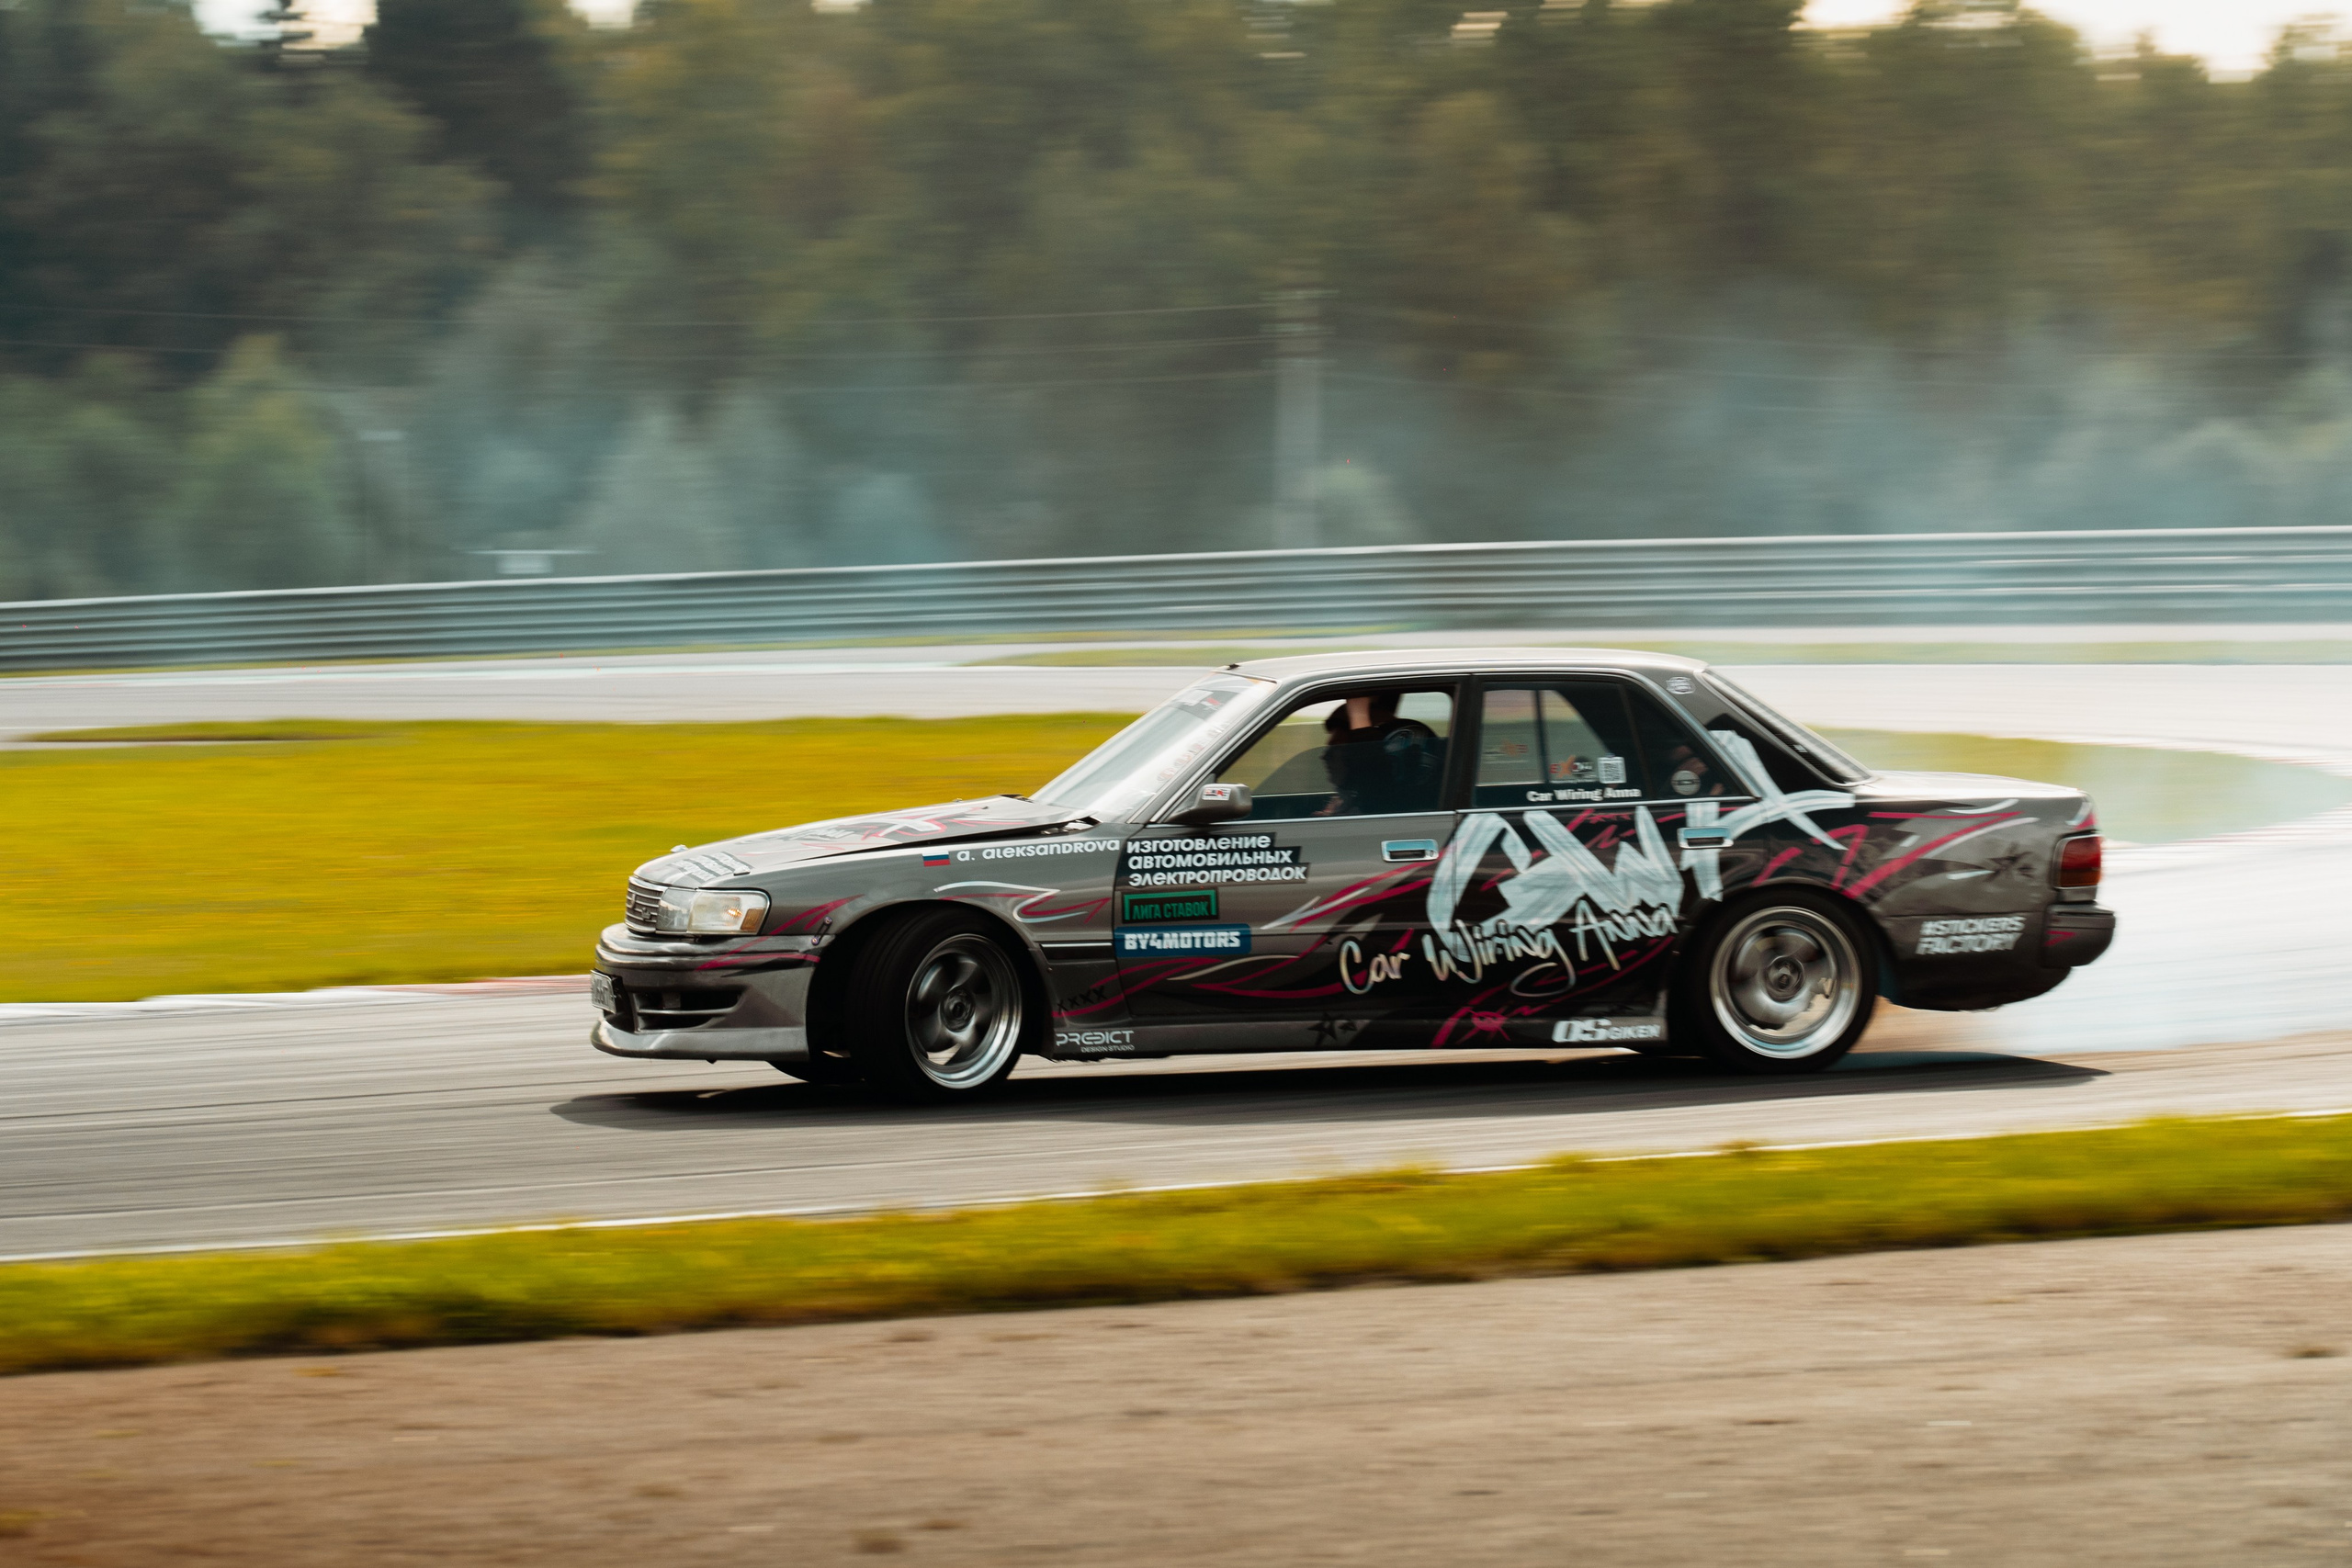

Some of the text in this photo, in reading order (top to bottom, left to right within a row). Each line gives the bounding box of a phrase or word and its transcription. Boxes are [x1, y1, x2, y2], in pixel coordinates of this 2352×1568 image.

[1526, 790, 1553, 802] Car
[1132, 901, 1209, 919] ЛИГА СТАВОК
[1124, 931, 1241, 950] BY4MOTORS
[1915, 932, 2023, 954] FACTORY
[1340, 939, 1411, 995] Car
